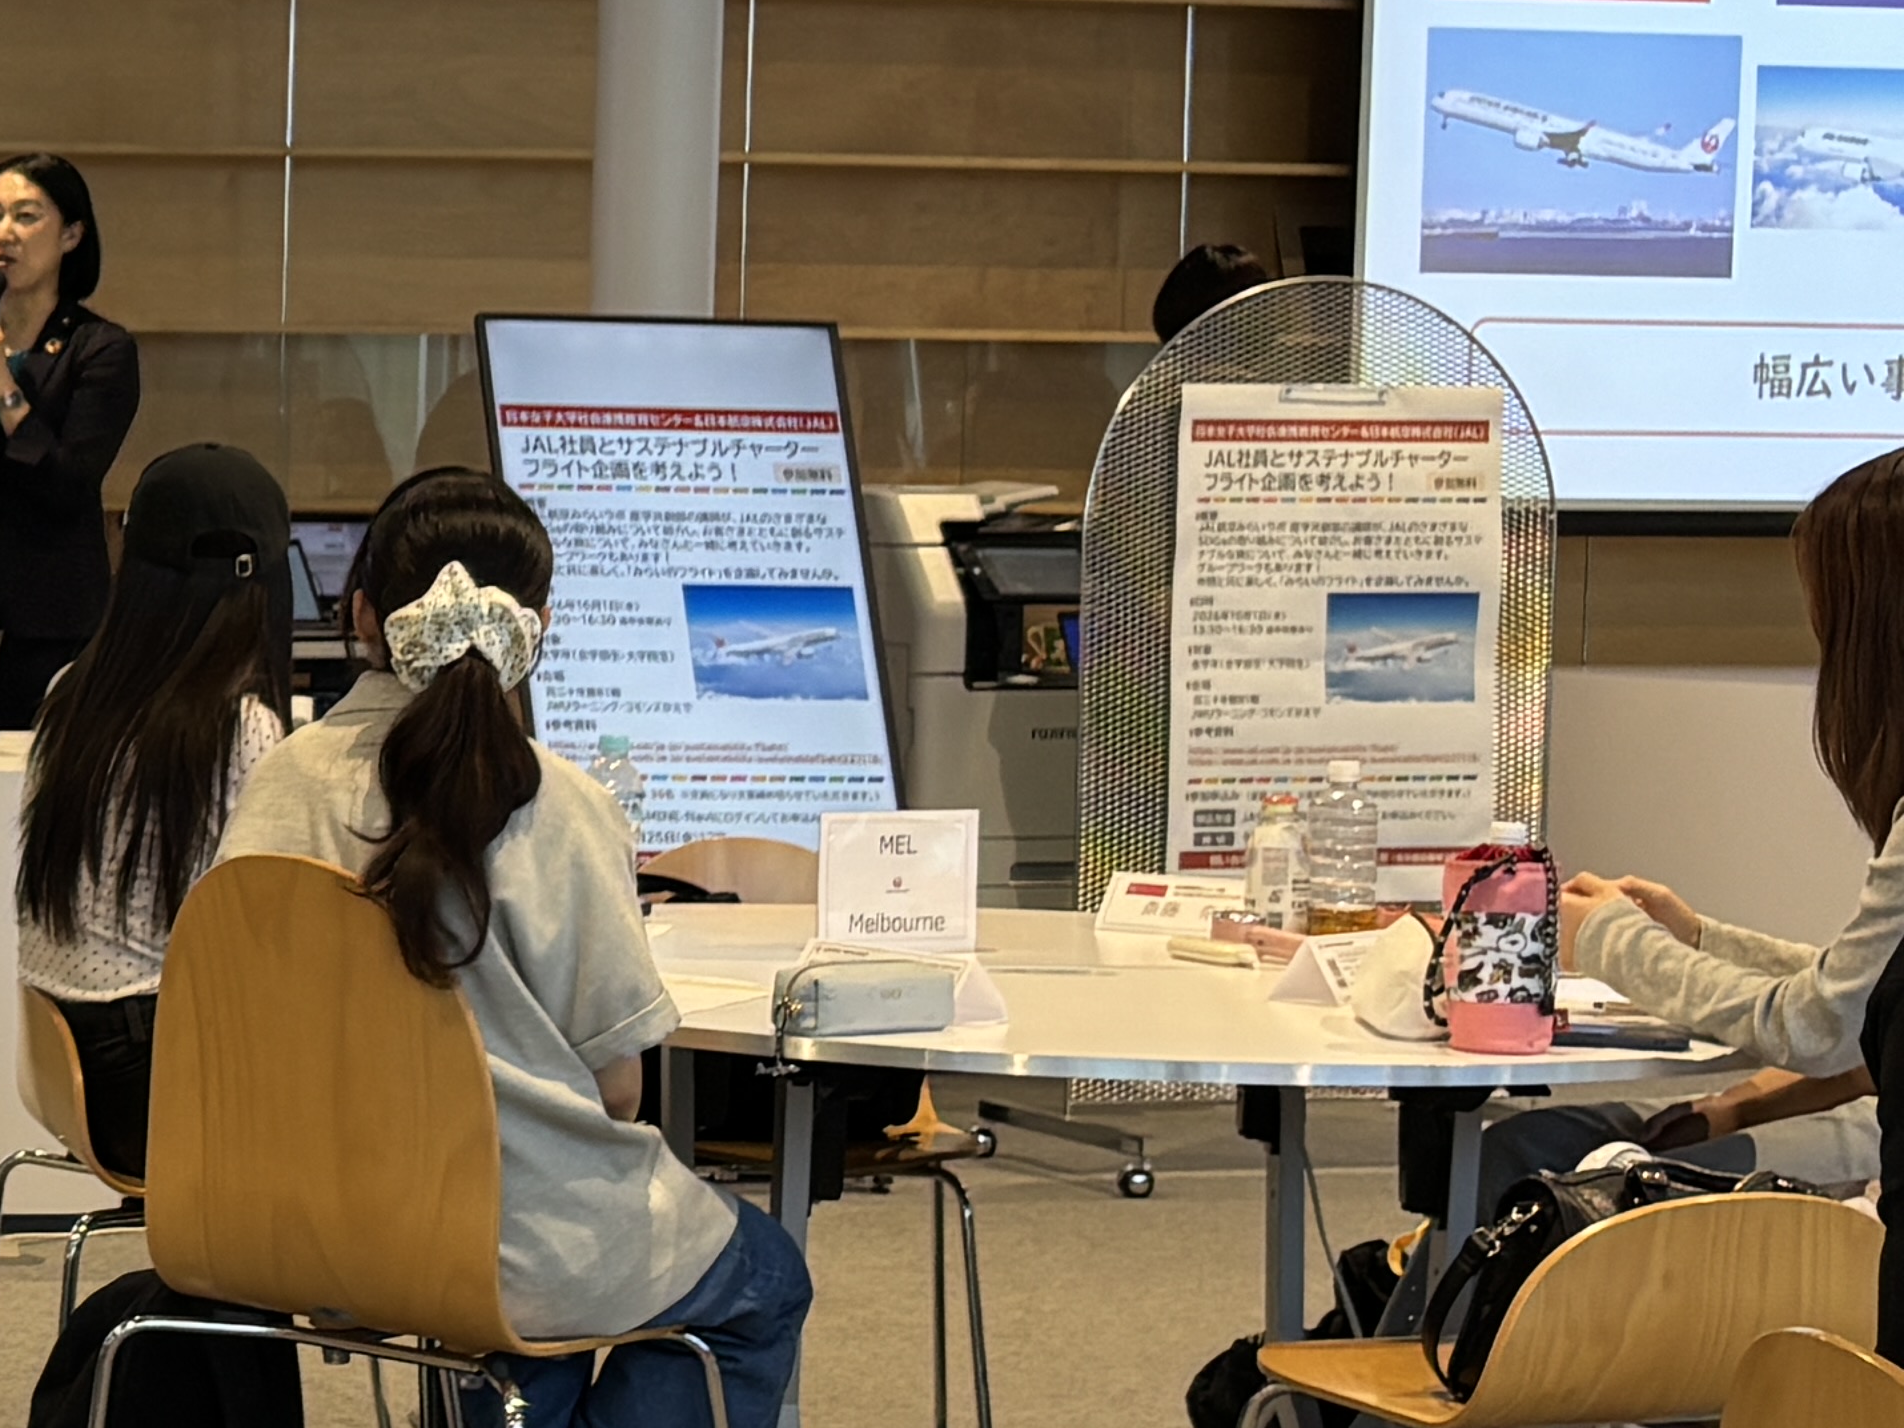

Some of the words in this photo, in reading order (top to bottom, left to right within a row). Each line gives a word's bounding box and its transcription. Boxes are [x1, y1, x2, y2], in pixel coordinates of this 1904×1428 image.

[521, 434, 820, 459] JAL社員とサステナブルチャーター
[1204, 448, 1469, 470] JAL社員とサステナブルチャーター
[879, 834, 918, 855] MEL
[848, 912, 946, 934] Melbourne
